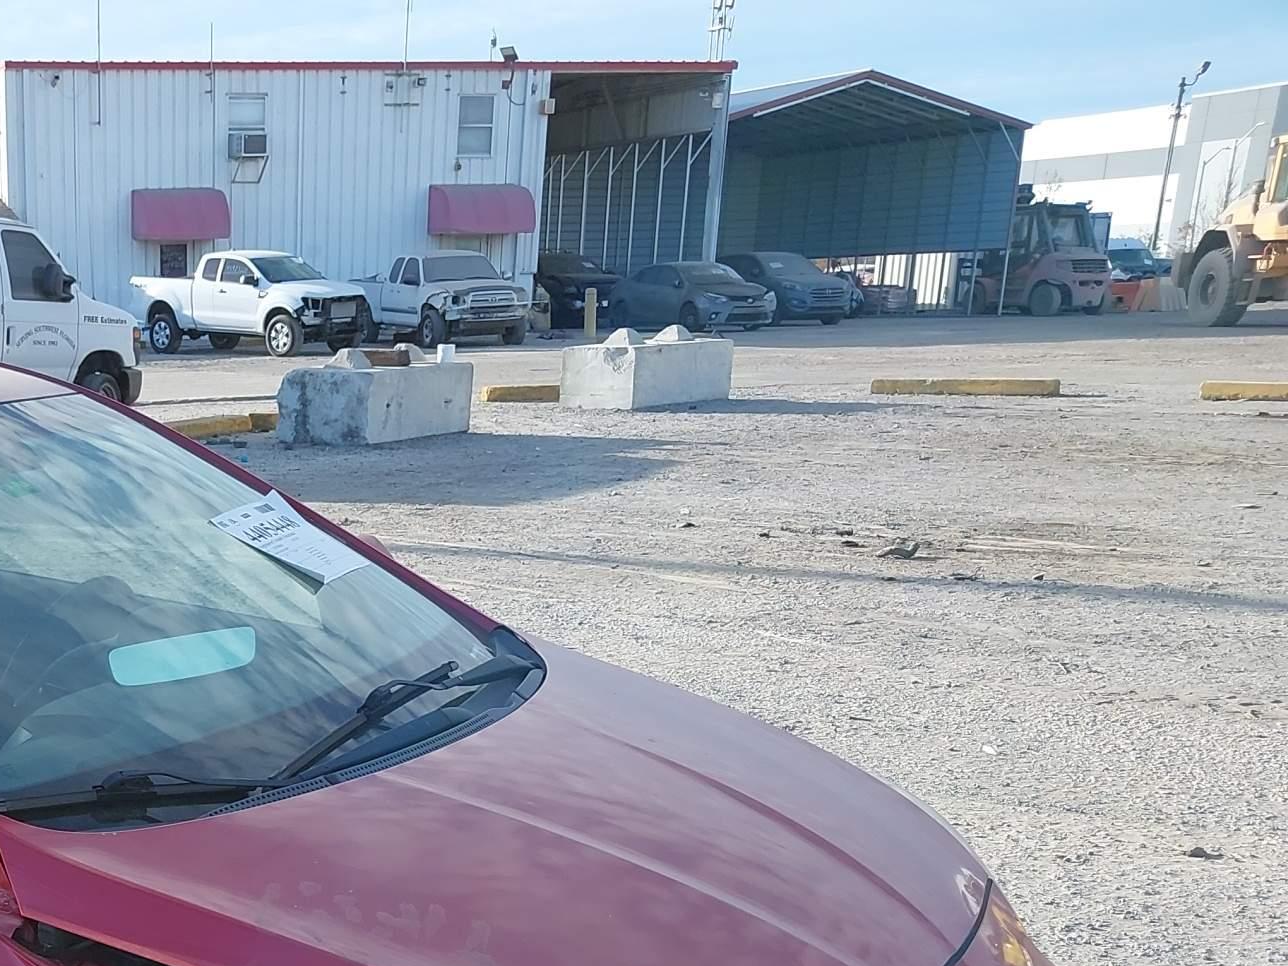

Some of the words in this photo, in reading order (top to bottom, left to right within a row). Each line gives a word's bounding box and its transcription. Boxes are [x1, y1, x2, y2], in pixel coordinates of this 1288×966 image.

[83, 315, 99, 323] FREE
[100, 316, 128, 325] Estimates
[242, 514, 302, 543] 44054448
